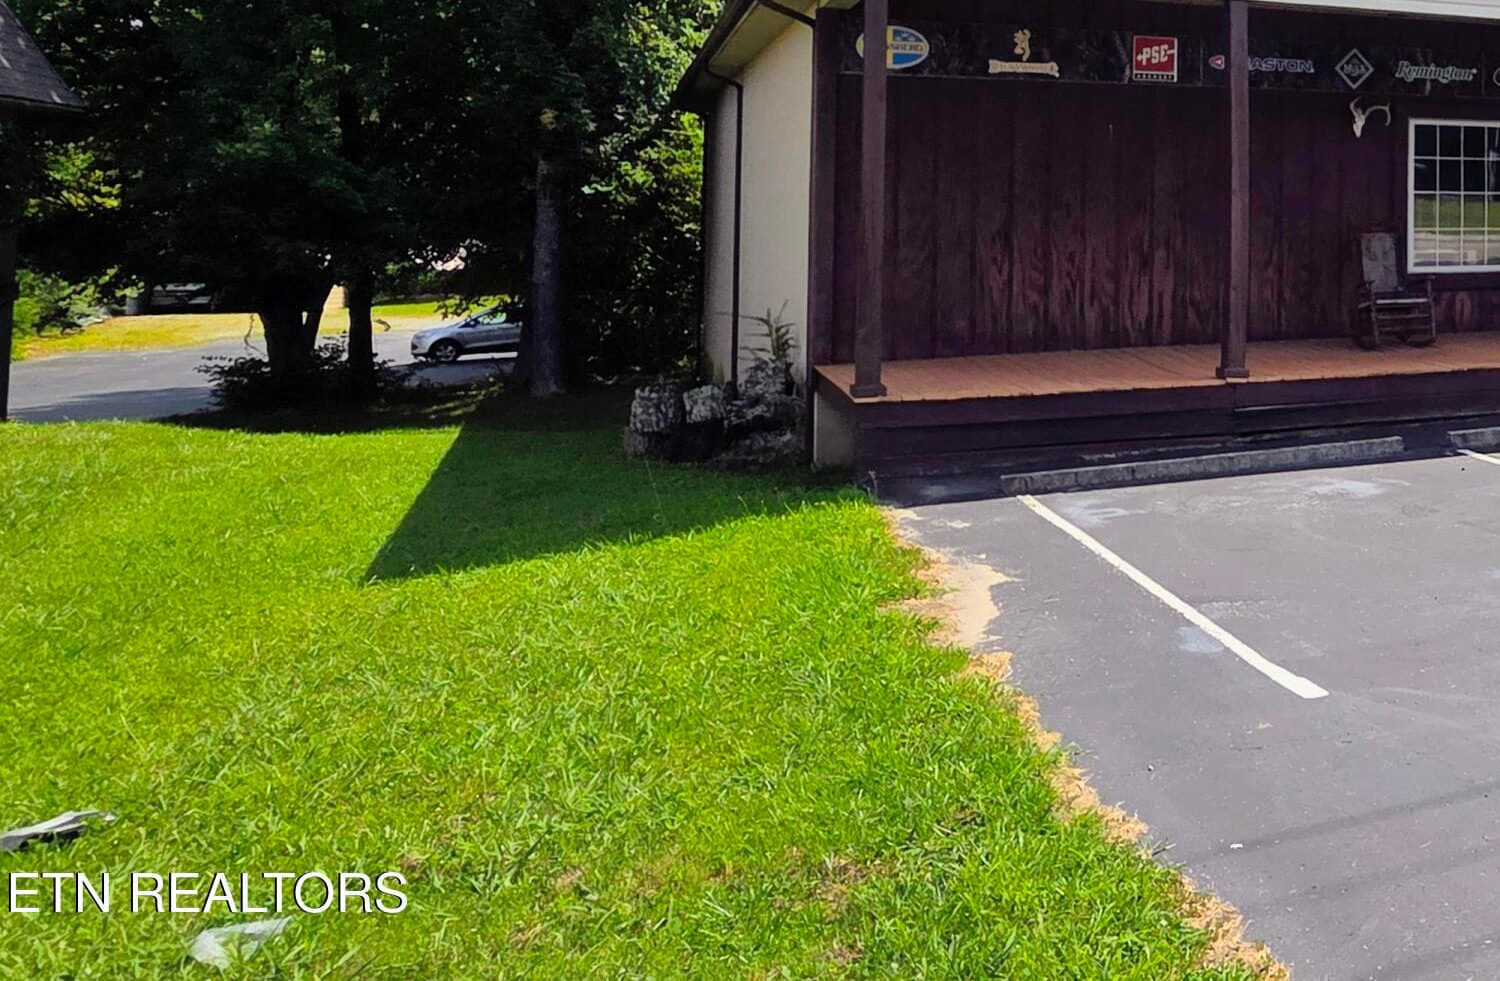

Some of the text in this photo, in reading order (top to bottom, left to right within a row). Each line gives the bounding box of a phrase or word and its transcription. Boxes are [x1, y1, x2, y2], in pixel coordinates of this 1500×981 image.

[1139, 44, 1169, 66] PSE
[1249, 57, 1314, 73] ASTON
[1395, 61, 1474, 83] Remington
